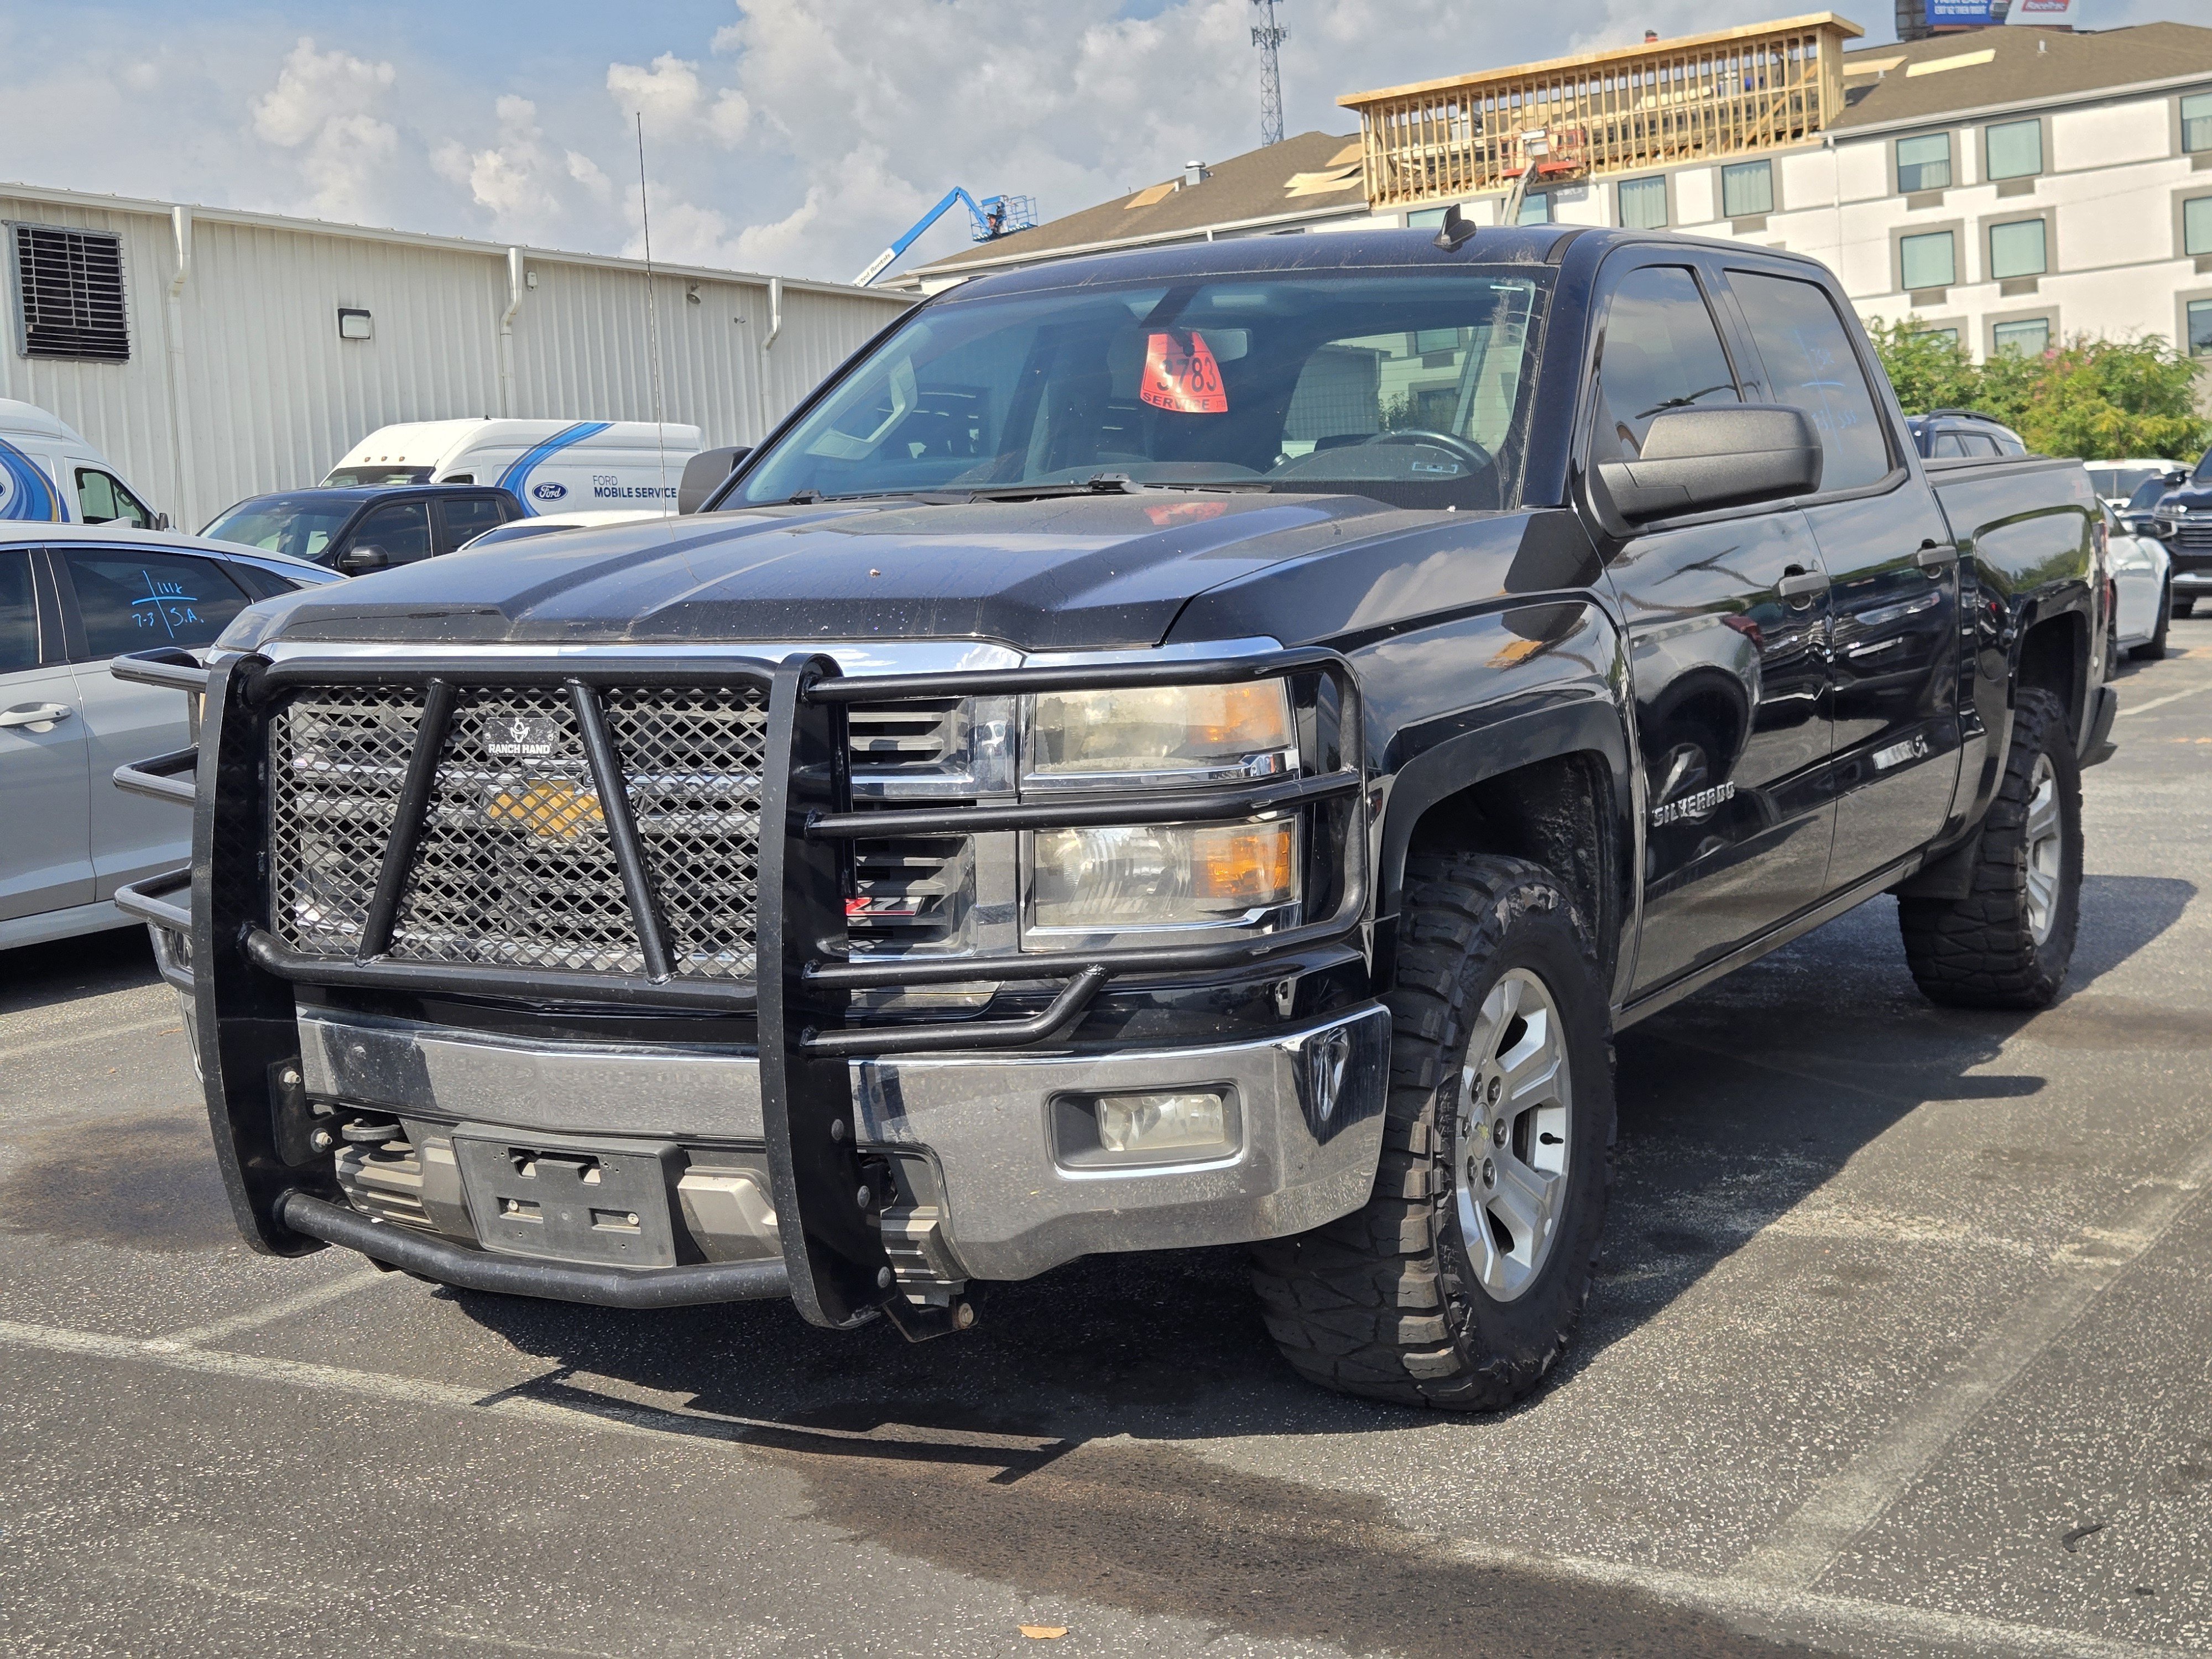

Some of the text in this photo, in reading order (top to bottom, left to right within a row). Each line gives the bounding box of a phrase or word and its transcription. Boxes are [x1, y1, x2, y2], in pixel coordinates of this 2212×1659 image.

[870, 253, 891, 274] Rentals
[593, 475, 618, 486] FORD
[594, 487, 677, 498] MOBILE SERVICE
[132, 612, 154, 628] 7-3
[488, 744, 550, 754] RANCH HAND
[1652, 780, 1735, 827] SILVERADO
[846, 897, 923, 916] Z71
